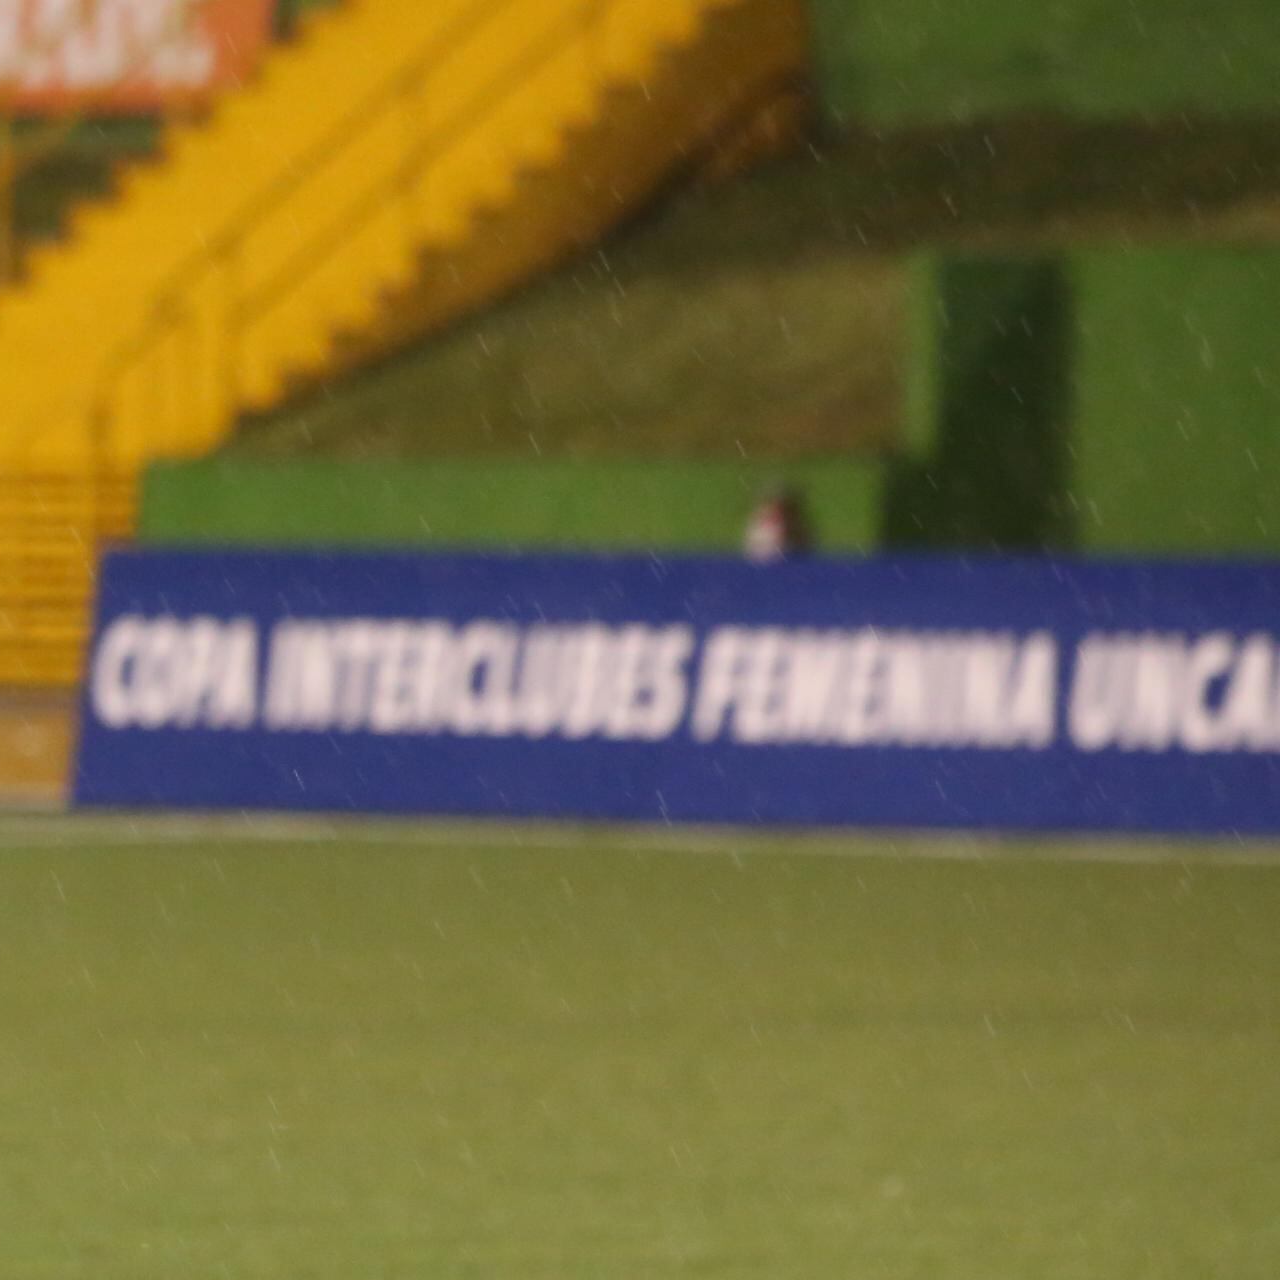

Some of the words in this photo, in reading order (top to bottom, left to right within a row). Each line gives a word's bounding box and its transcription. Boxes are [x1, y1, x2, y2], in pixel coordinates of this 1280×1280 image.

[90, 615, 257, 731] COPA
[263, 618, 694, 742] INTERCLUBES
[690, 626, 1057, 748] FEMENINA
